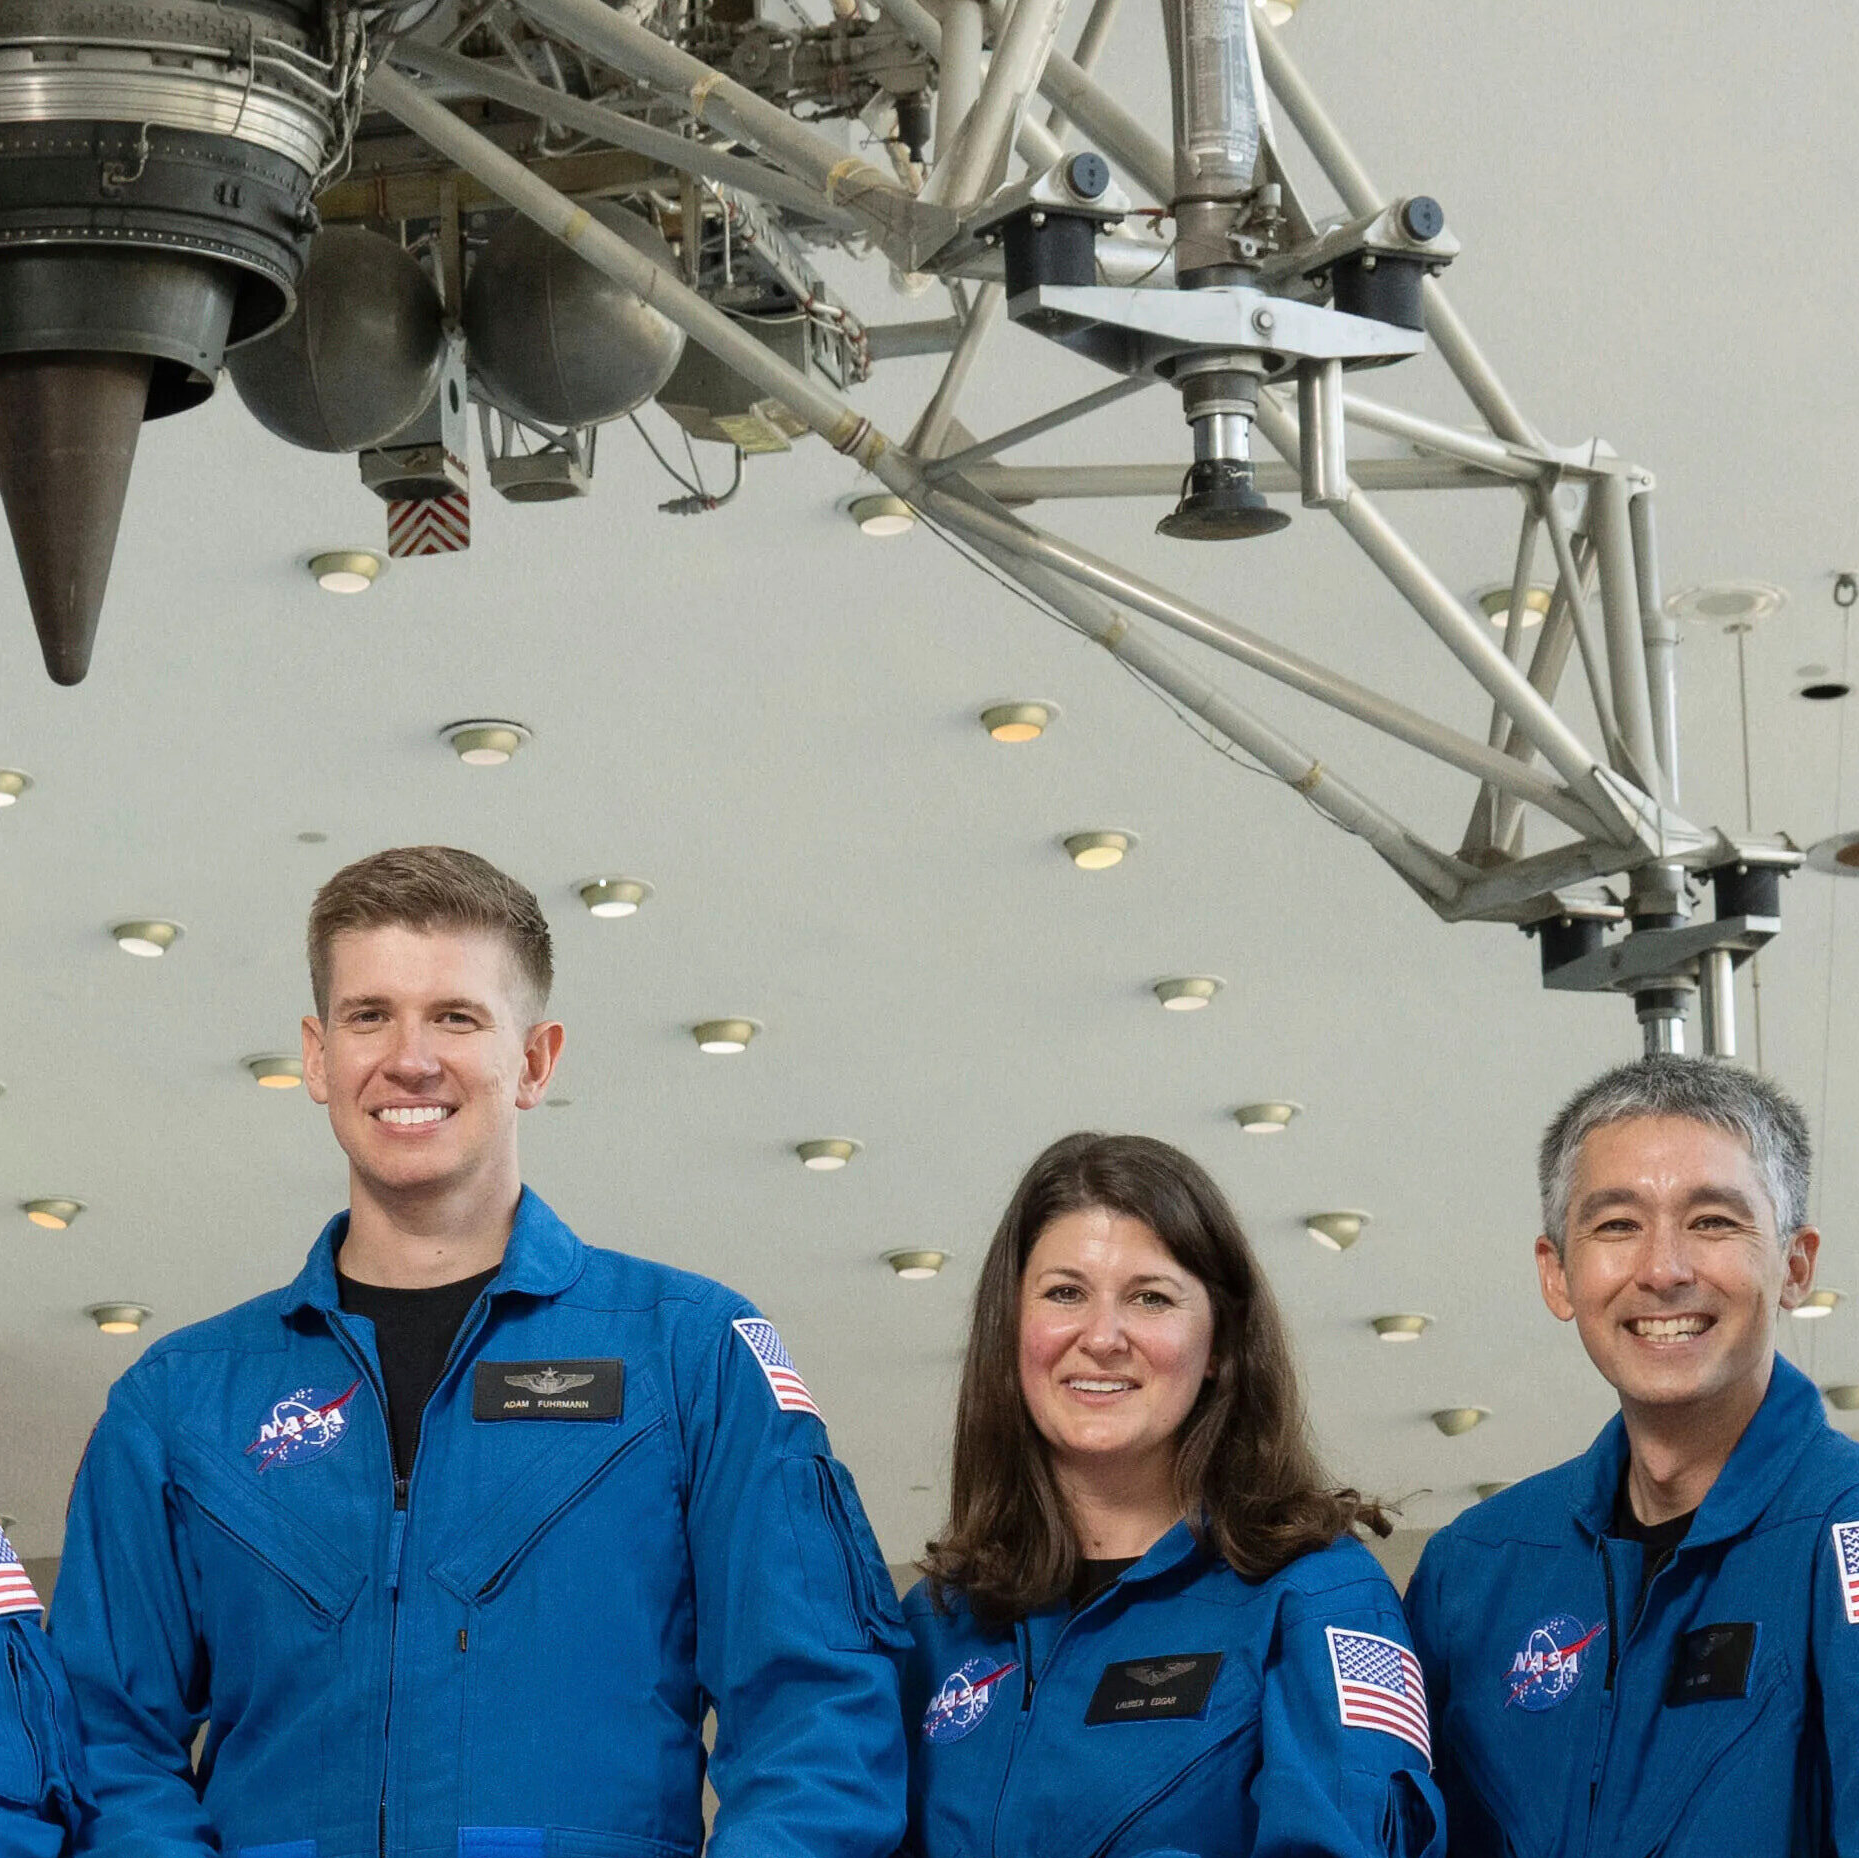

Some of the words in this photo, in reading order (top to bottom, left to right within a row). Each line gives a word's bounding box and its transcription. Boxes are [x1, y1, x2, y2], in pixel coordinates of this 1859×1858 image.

[503, 1400, 529, 1410] ADAM
[537, 1400, 589, 1410] FUHRMANN
[259, 1408, 345, 1442] NASA
[1512, 1651, 1579, 1674] NASA
[926, 1684, 989, 1716] NASA
[1115, 1698, 1145, 1711] LAUREN
[1150, 1696, 1177, 1707] EDGAR
